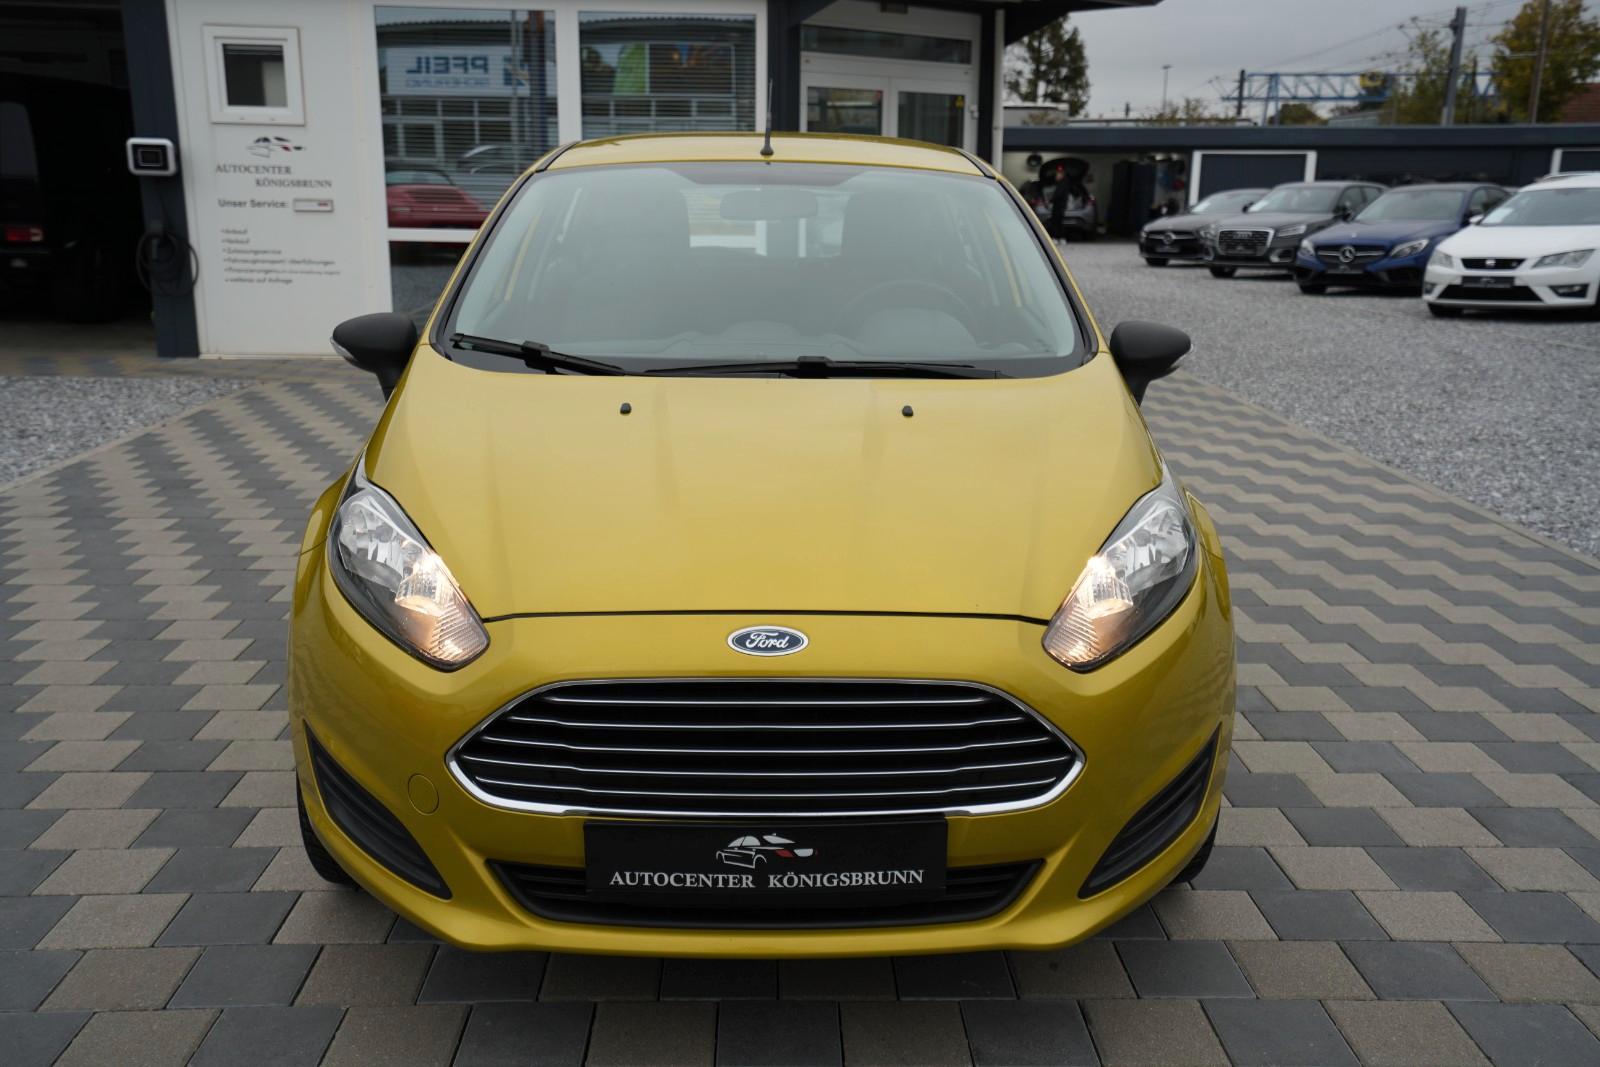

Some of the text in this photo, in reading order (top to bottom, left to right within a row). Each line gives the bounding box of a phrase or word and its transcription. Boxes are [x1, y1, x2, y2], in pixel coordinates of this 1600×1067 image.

[215, 164, 291, 175] AUTOCENTER
[255, 178, 332, 189] KÖNIGSBRUNN
[218, 199, 247, 208] Unser
[746, 632, 790, 648] Ford
[609, 870, 924, 888] AUTOCENTER KÖNIGSBRUNN
